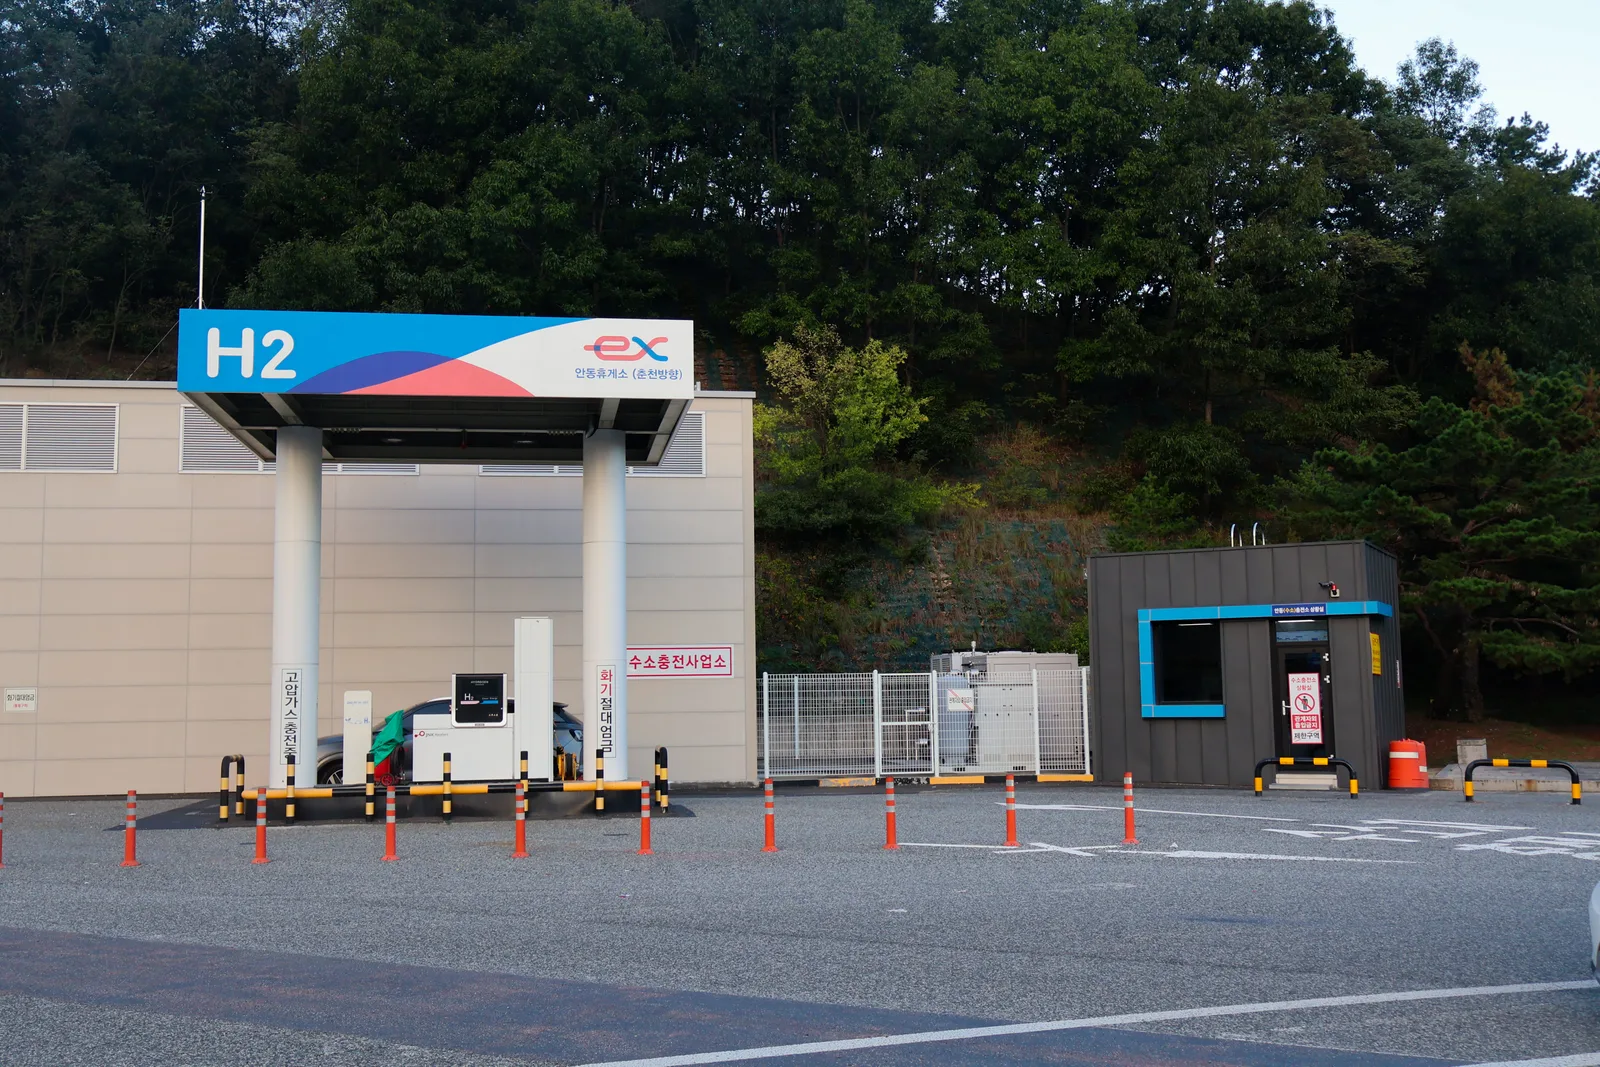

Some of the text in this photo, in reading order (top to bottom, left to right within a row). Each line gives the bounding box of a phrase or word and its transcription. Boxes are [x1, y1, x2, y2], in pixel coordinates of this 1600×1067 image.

[207, 327, 297, 379] H2
[583, 335, 669, 362] ex
[574, 367, 683, 380] 안동휴게소 (춘천방향)
[629, 654, 727, 670] 수소충전사업소
[600, 669, 613, 753] 화기절대엄금
